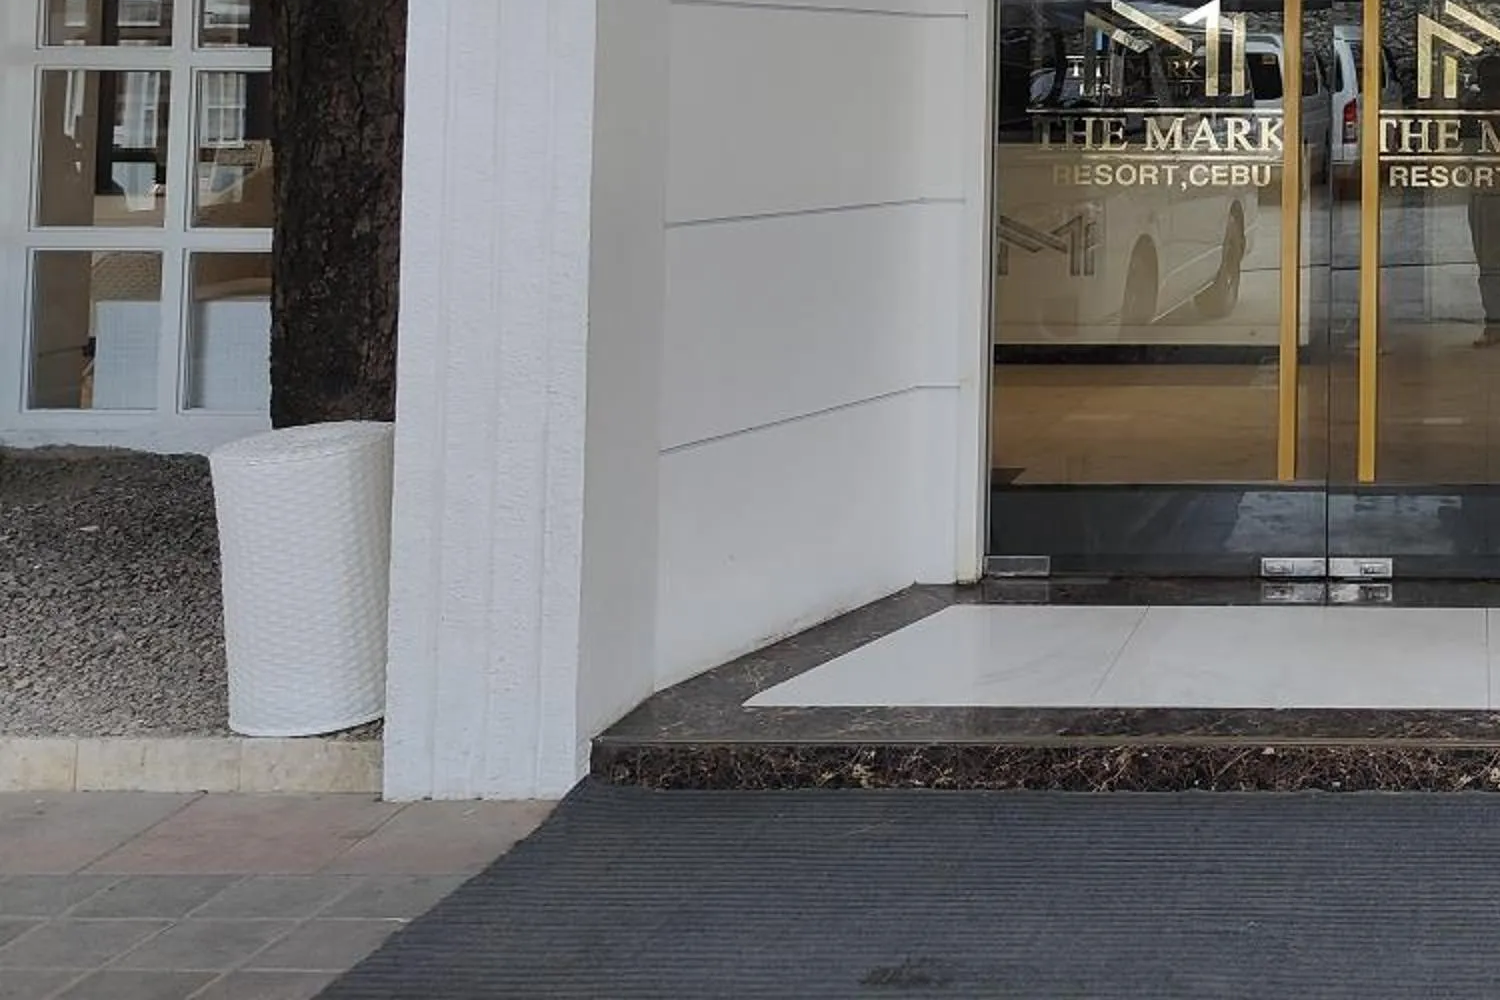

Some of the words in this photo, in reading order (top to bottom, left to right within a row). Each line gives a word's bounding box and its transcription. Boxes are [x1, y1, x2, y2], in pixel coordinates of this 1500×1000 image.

[1032, 116, 1128, 151] THE
[1143, 116, 1284, 151] MARK
[1380, 119, 1464, 153] THE
